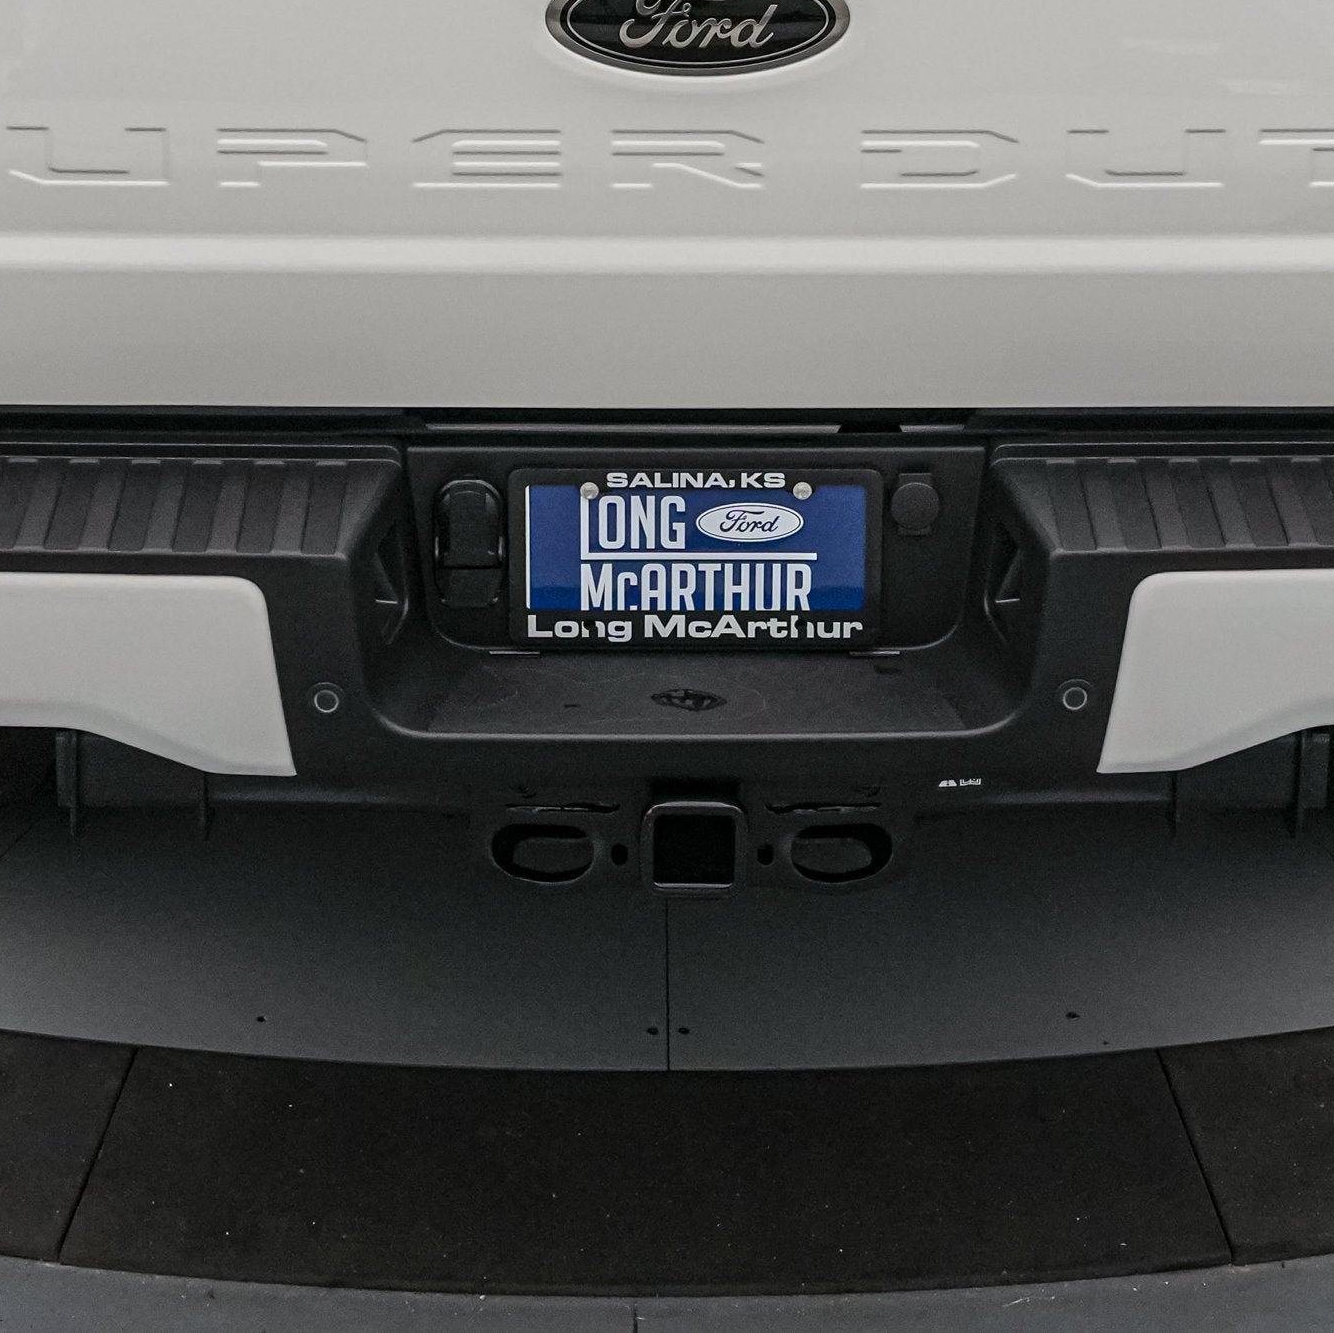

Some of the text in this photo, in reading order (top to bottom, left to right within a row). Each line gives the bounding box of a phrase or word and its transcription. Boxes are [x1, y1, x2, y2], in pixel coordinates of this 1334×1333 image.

[606, 472, 786, 489] SALINA, KS
[580, 494, 780, 555] LONG Ford
[580, 563, 812, 611] McARTHUR
[527, 614, 863, 642] Long McArthur
